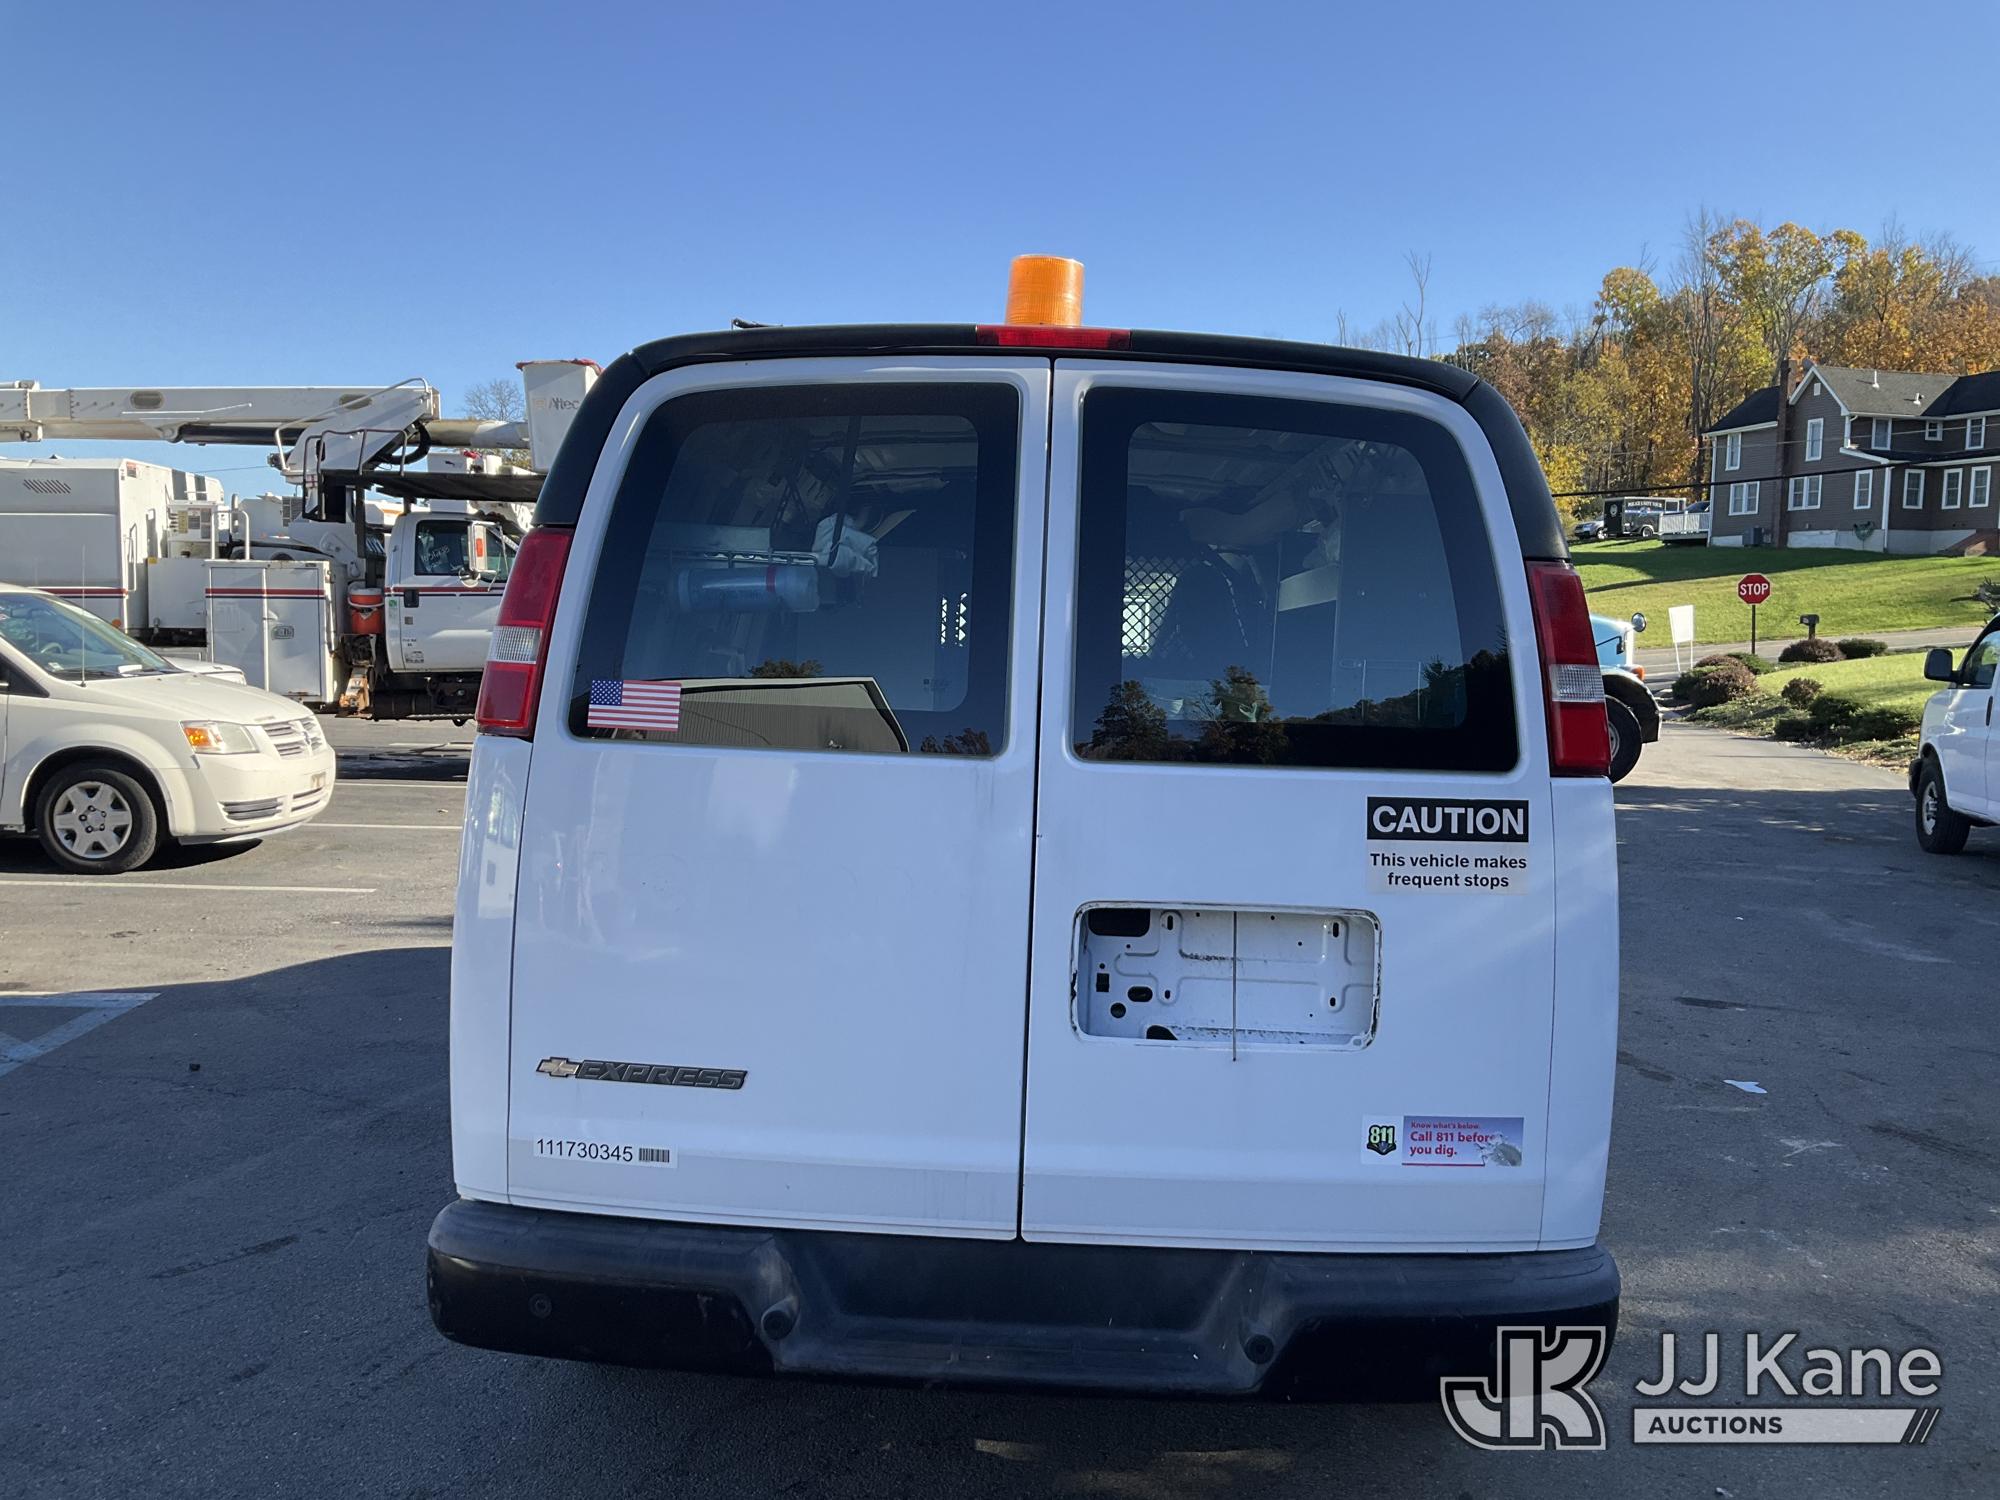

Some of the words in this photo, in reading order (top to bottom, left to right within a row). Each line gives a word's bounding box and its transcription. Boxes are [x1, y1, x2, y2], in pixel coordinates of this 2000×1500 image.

[1740, 583, 1768, 596] STOP
[1372, 805, 1524, 835] CAUTION
[1370, 853, 1405, 867] This
[1410, 854, 1469, 868] vehicle
[1474, 855, 1527, 869] makes
[1388, 872, 1460, 889] frequent
[1464, 874, 1509, 890] stops
[577, 1060, 747, 1089] EXPRESS
[1411, 1121, 1431, 1129] Know
[1369, 1125, 1396, 1144] 811
[1410, 1131, 1432, 1142] Call
[1436, 1132, 1454, 1142] 811
[536, 1138, 633, 1163] 111730345
[1410, 1146, 1432, 1157] you
[1435, 1144, 1457, 1158] dig.
